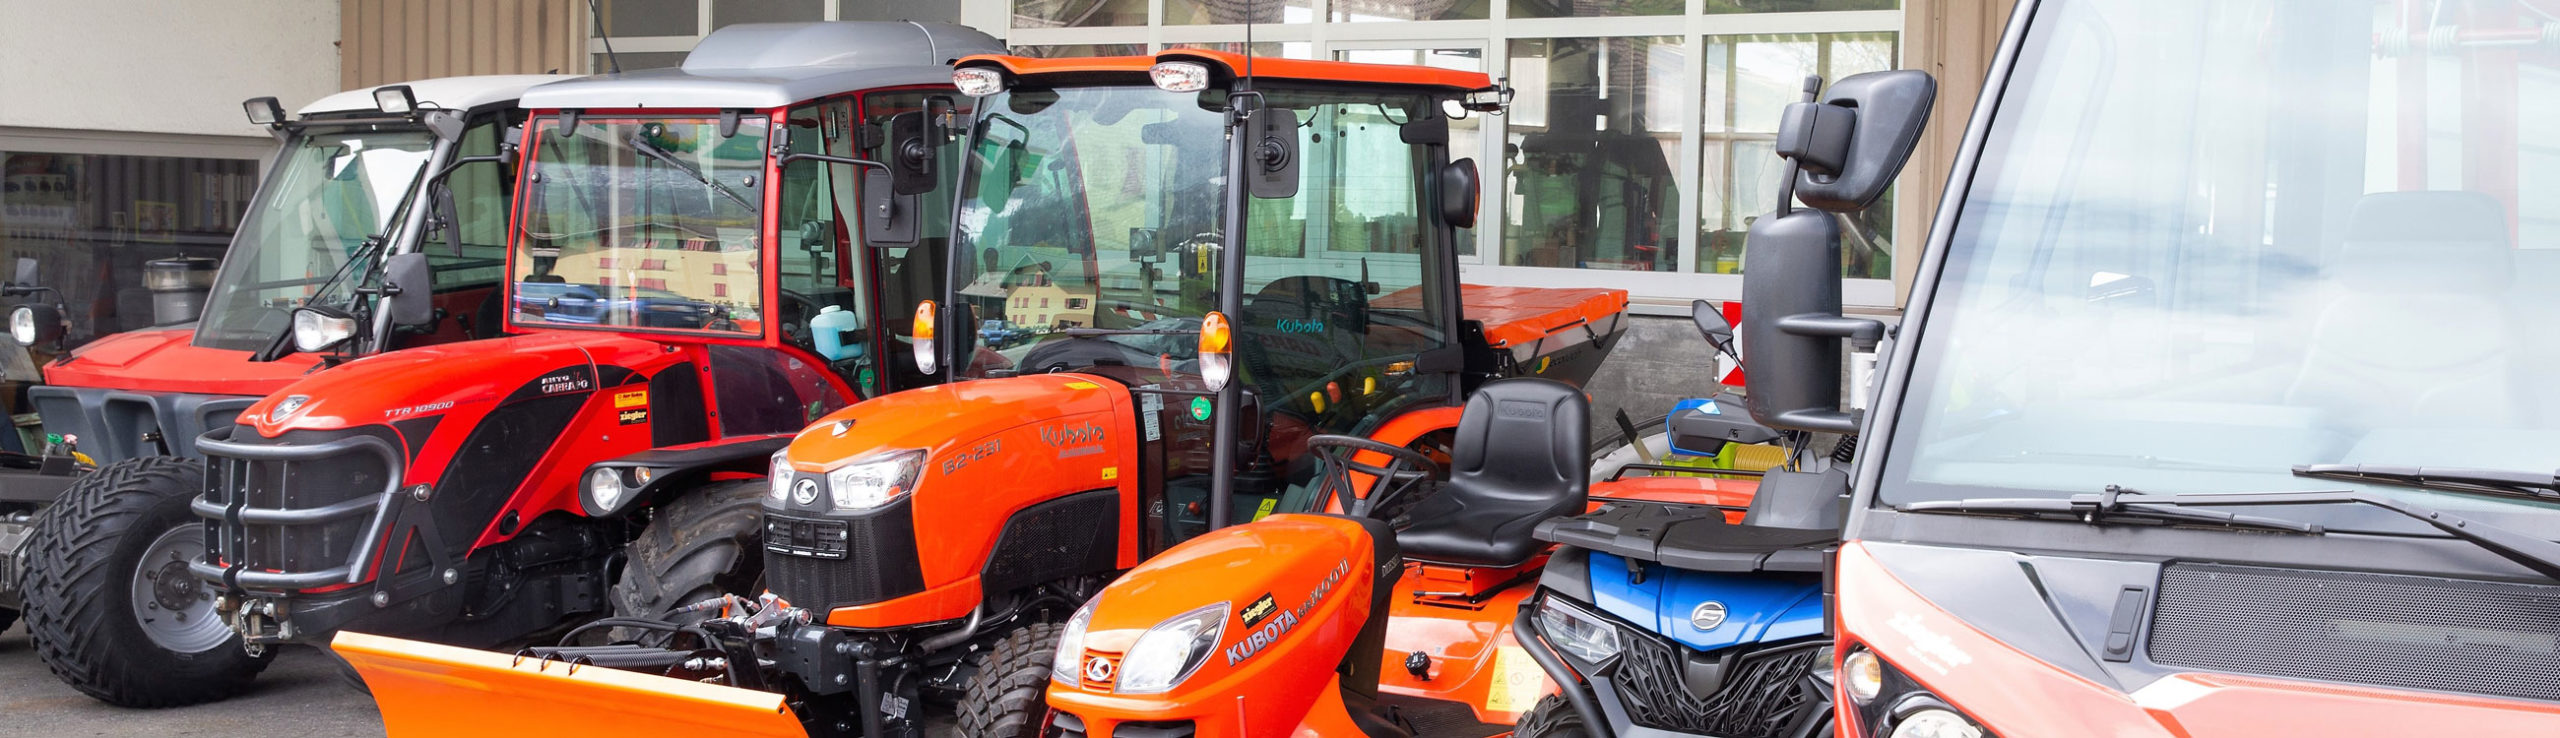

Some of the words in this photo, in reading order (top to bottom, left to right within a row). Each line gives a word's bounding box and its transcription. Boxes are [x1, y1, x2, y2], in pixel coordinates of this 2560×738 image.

[1276, 318, 1324, 333] Kubota
[384, 407, 412, 417] TTR
[414, 401, 454, 414] 10900
[620, 410, 647, 421] ziegler
[1040, 421, 1105, 447] Kubota
[942, 438, 1001, 476] B2-231
[1242, 596, 1273, 623] ziegler
[1225, 609, 1299, 667] KUBOTA
